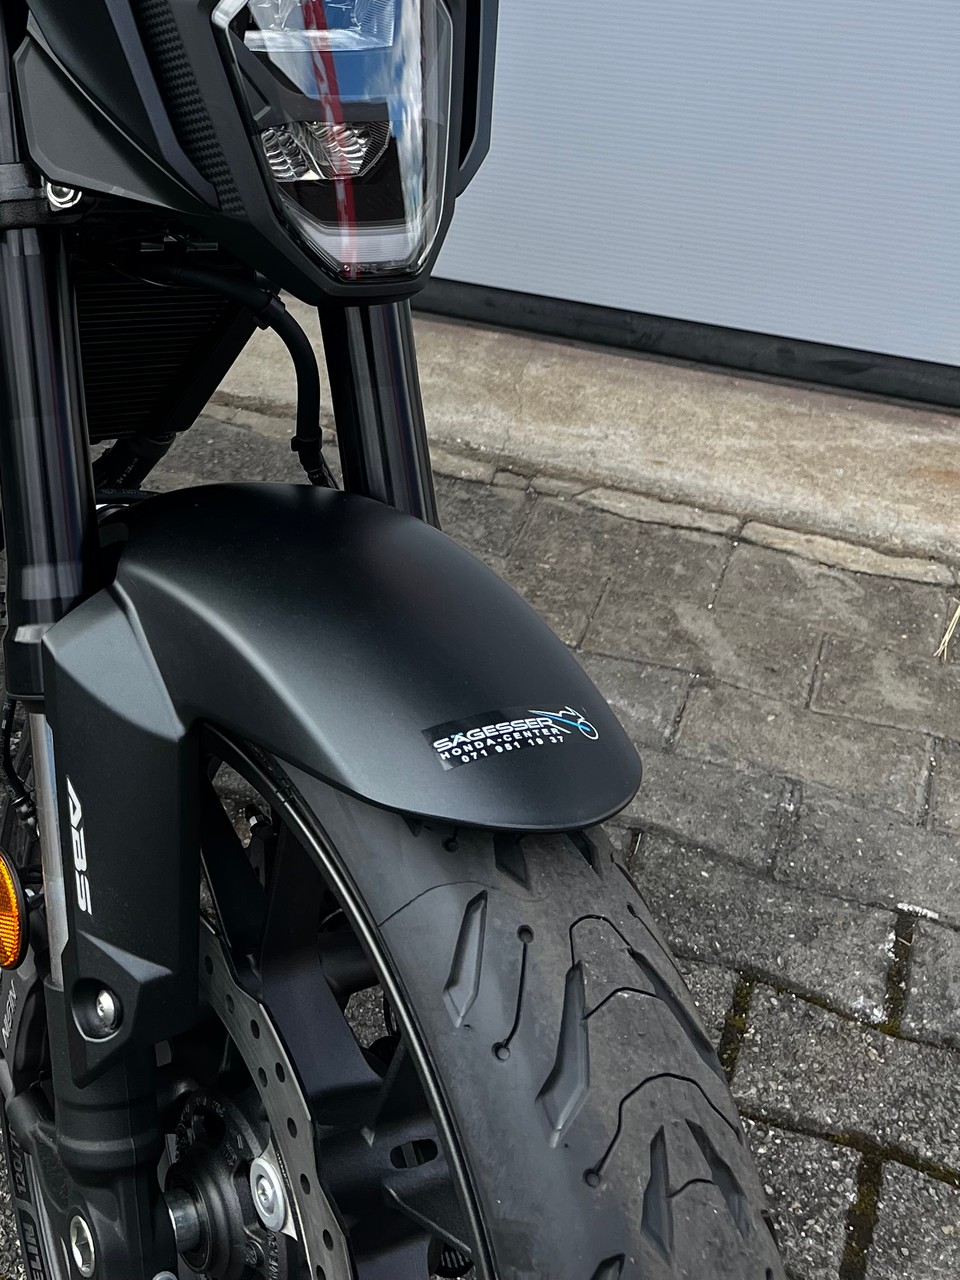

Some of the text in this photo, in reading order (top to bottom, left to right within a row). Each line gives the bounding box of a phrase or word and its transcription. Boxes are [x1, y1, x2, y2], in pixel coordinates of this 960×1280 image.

[433, 717, 571, 753] SÄGESSER
[440, 727, 561, 761] HONDA-CENTER
[461, 749, 488, 763] 071
[551, 735, 565, 744] 37
[66, 775, 93, 915] ABS
